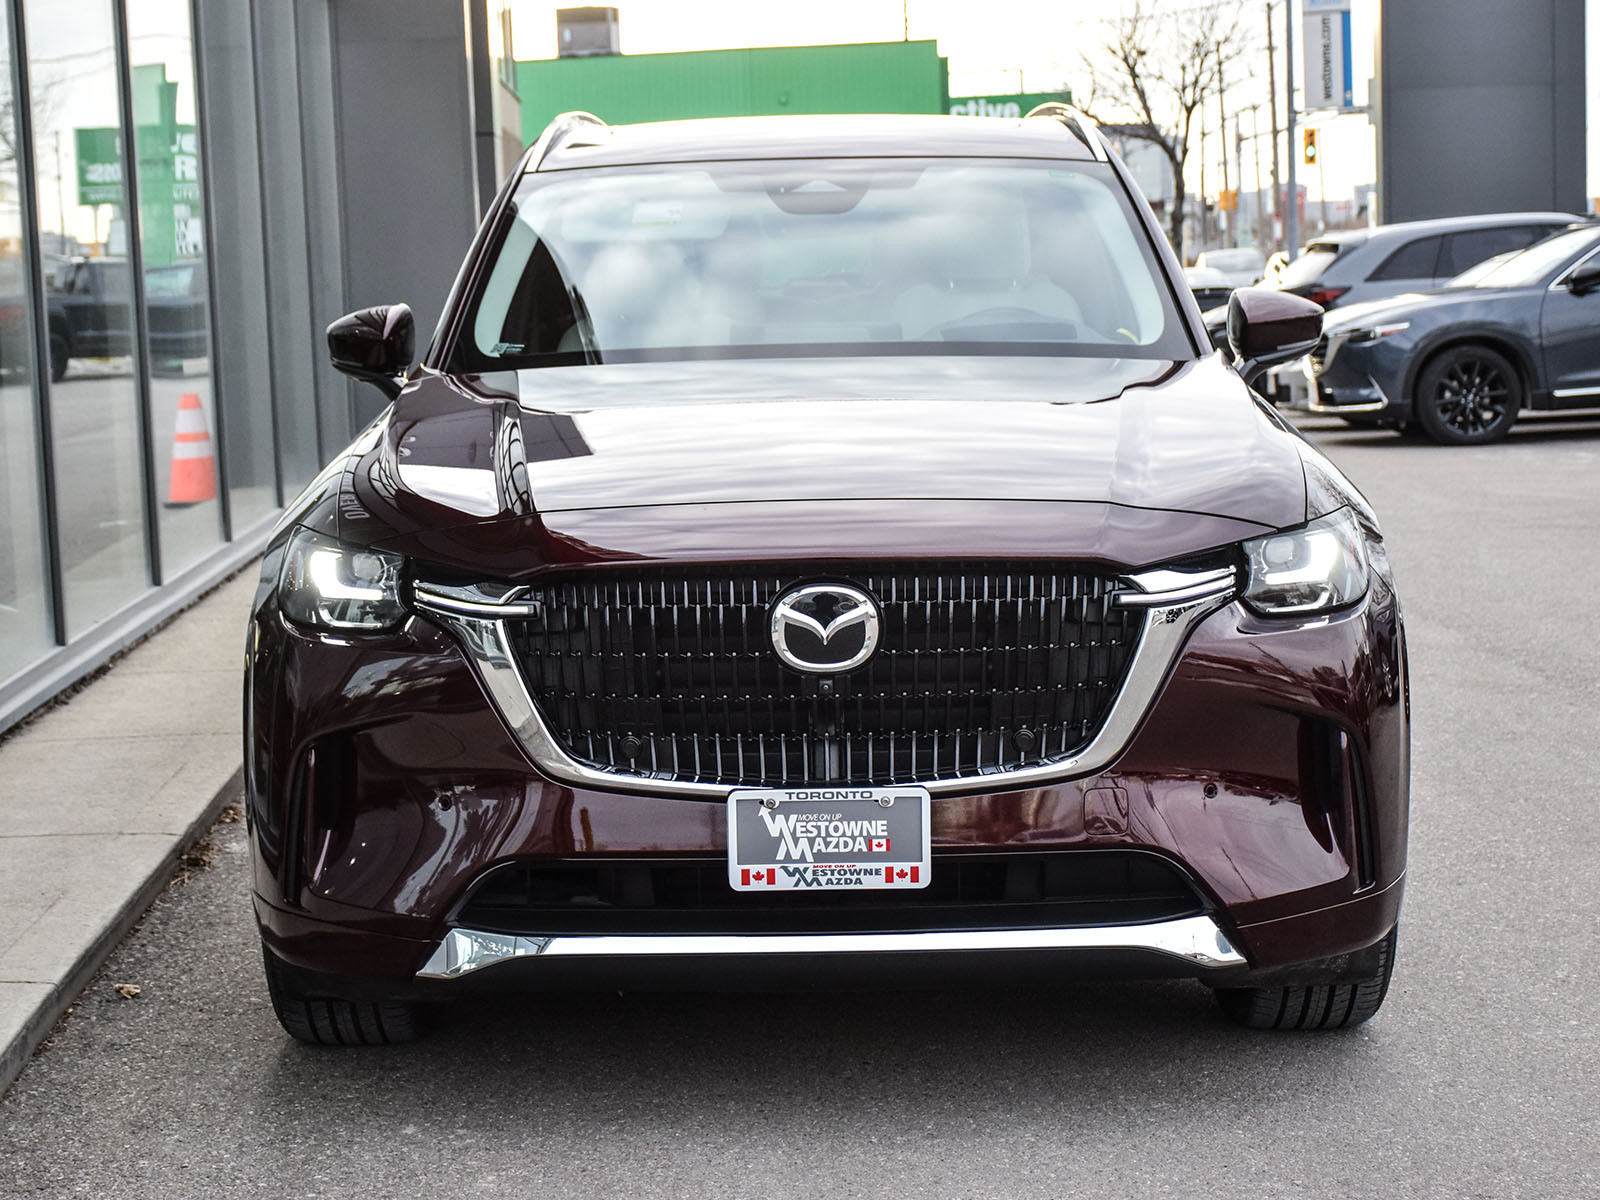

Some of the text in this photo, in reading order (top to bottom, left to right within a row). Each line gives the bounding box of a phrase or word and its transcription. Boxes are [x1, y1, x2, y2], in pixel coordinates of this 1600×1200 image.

[1321, 16, 1332, 100] westowne.com
[785, 790, 873, 800] TORONTO
[758, 806, 888, 838] WESTOWNE
[776, 837, 868, 862] MAZDA
[779, 865, 882, 877] WESTOWNE
[793, 876, 863, 888] MAZDA
